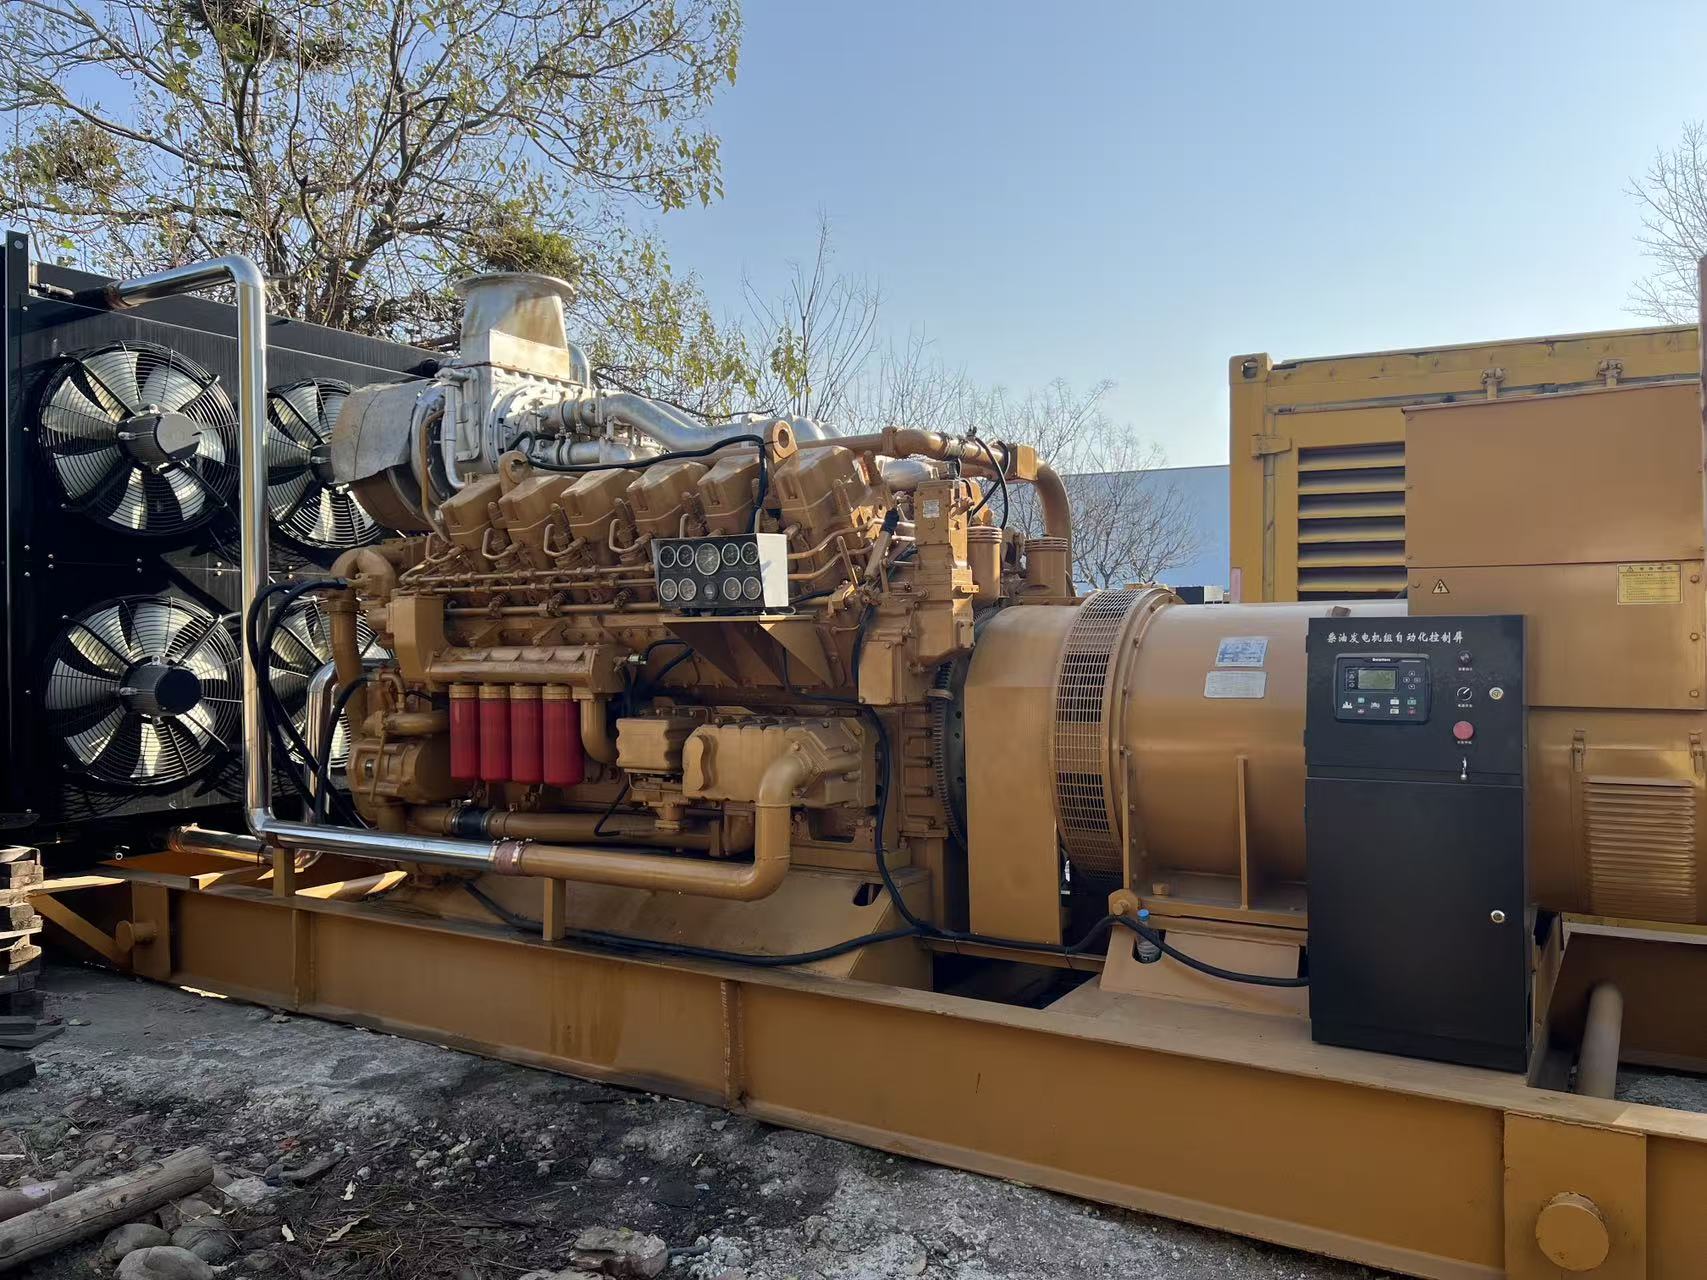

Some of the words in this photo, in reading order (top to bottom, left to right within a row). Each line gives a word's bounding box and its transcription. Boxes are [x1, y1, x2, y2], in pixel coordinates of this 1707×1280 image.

[1327, 630, 1463, 644] 柴油发电机组自动化控制屏
